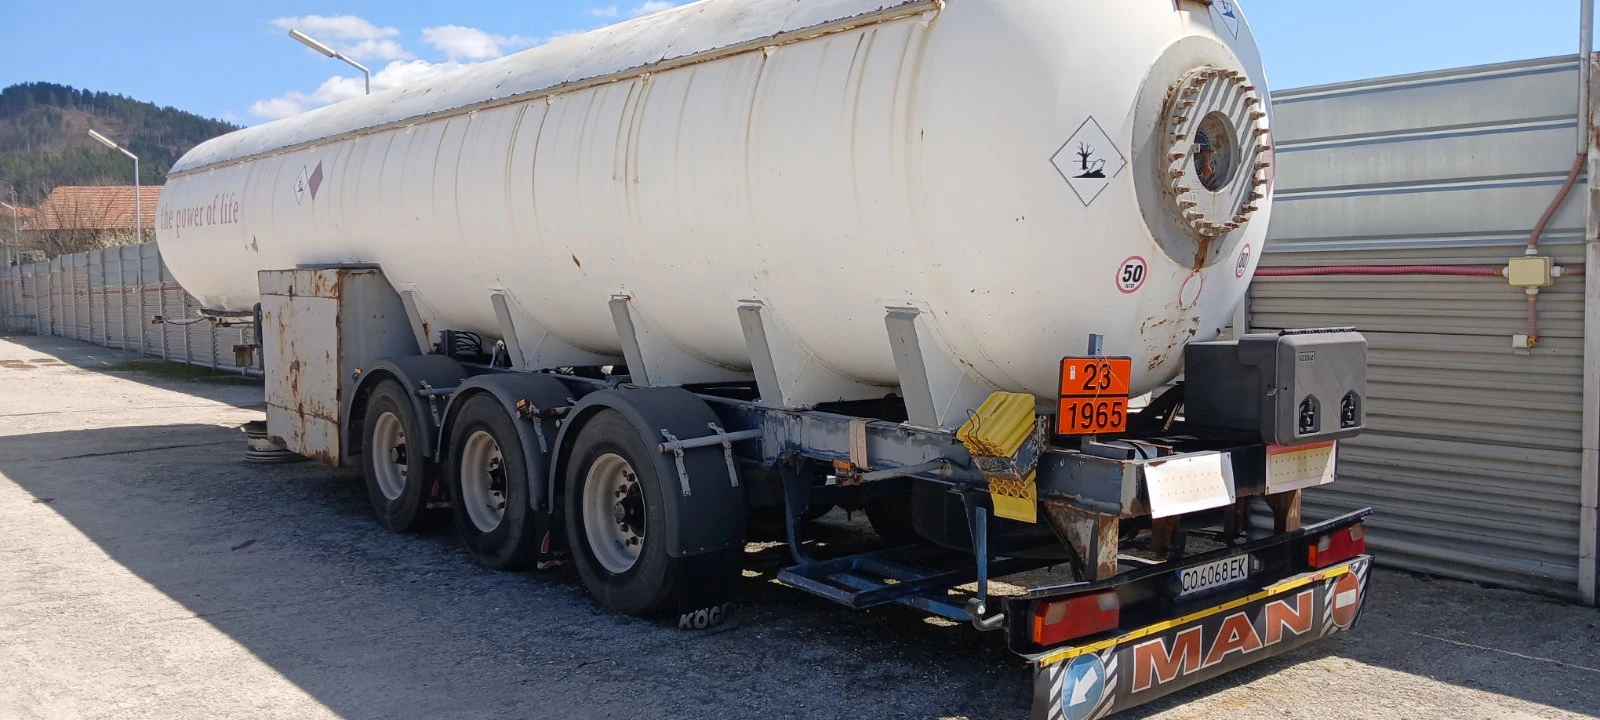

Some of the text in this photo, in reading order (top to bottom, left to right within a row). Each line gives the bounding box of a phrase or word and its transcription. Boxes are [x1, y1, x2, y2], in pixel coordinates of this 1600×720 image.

[160, 191, 240, 239] the power of life
[1122, 264, 1143, 283] 50
[1082, 362, 1112, 391] 23
[1067, 401, 1123, 430] 1965
[1131, 589, 1314, 694] MAN
